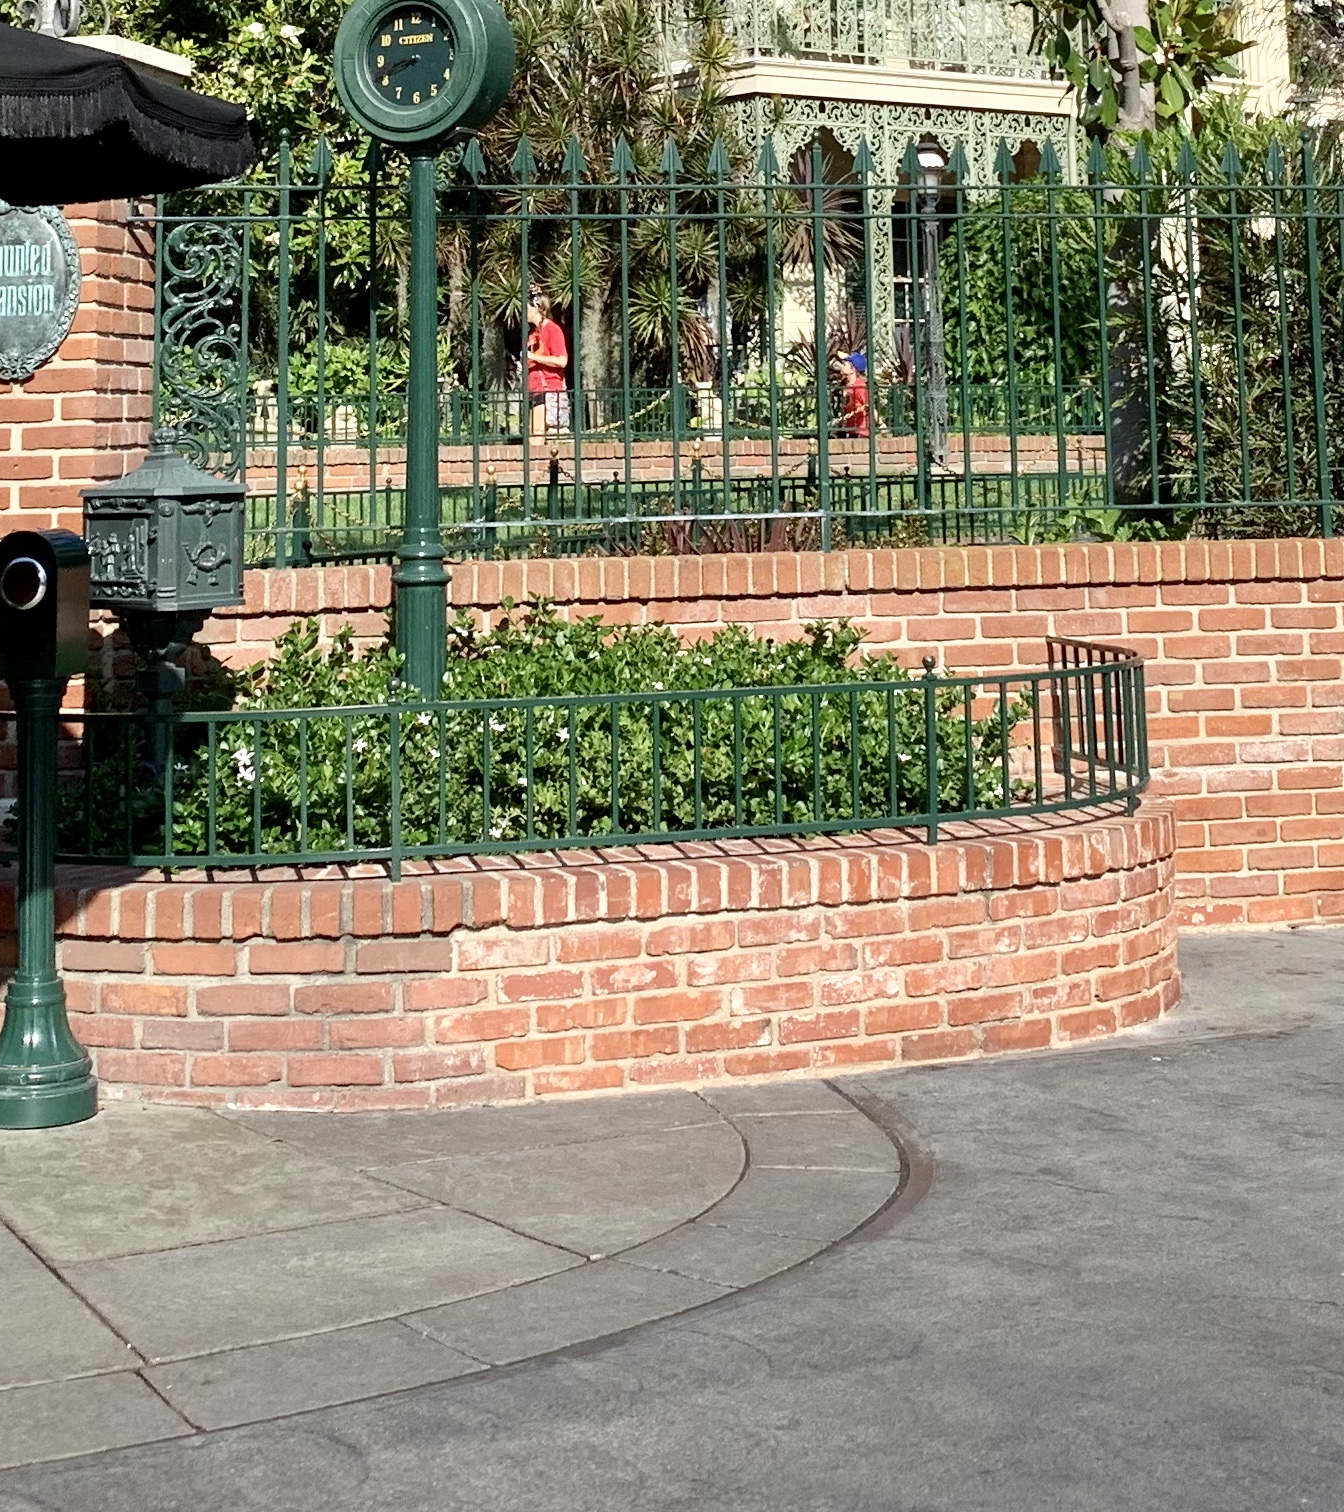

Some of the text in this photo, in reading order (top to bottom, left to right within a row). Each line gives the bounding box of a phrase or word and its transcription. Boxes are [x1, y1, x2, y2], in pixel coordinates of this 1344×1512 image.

[410, 12, 422, 24] 12
[393, 18, 404, 32] 11
[381, 34, 392, 47] 10
[398, 32, 434, 45] CITIZEN
[377, 55, 385, 68] 9
[443, 68, 450, 81] 4
[395, 86, 403, 100] 7
[430, 84, 438, 97] 5
[412, 91, 421, 104] 6
